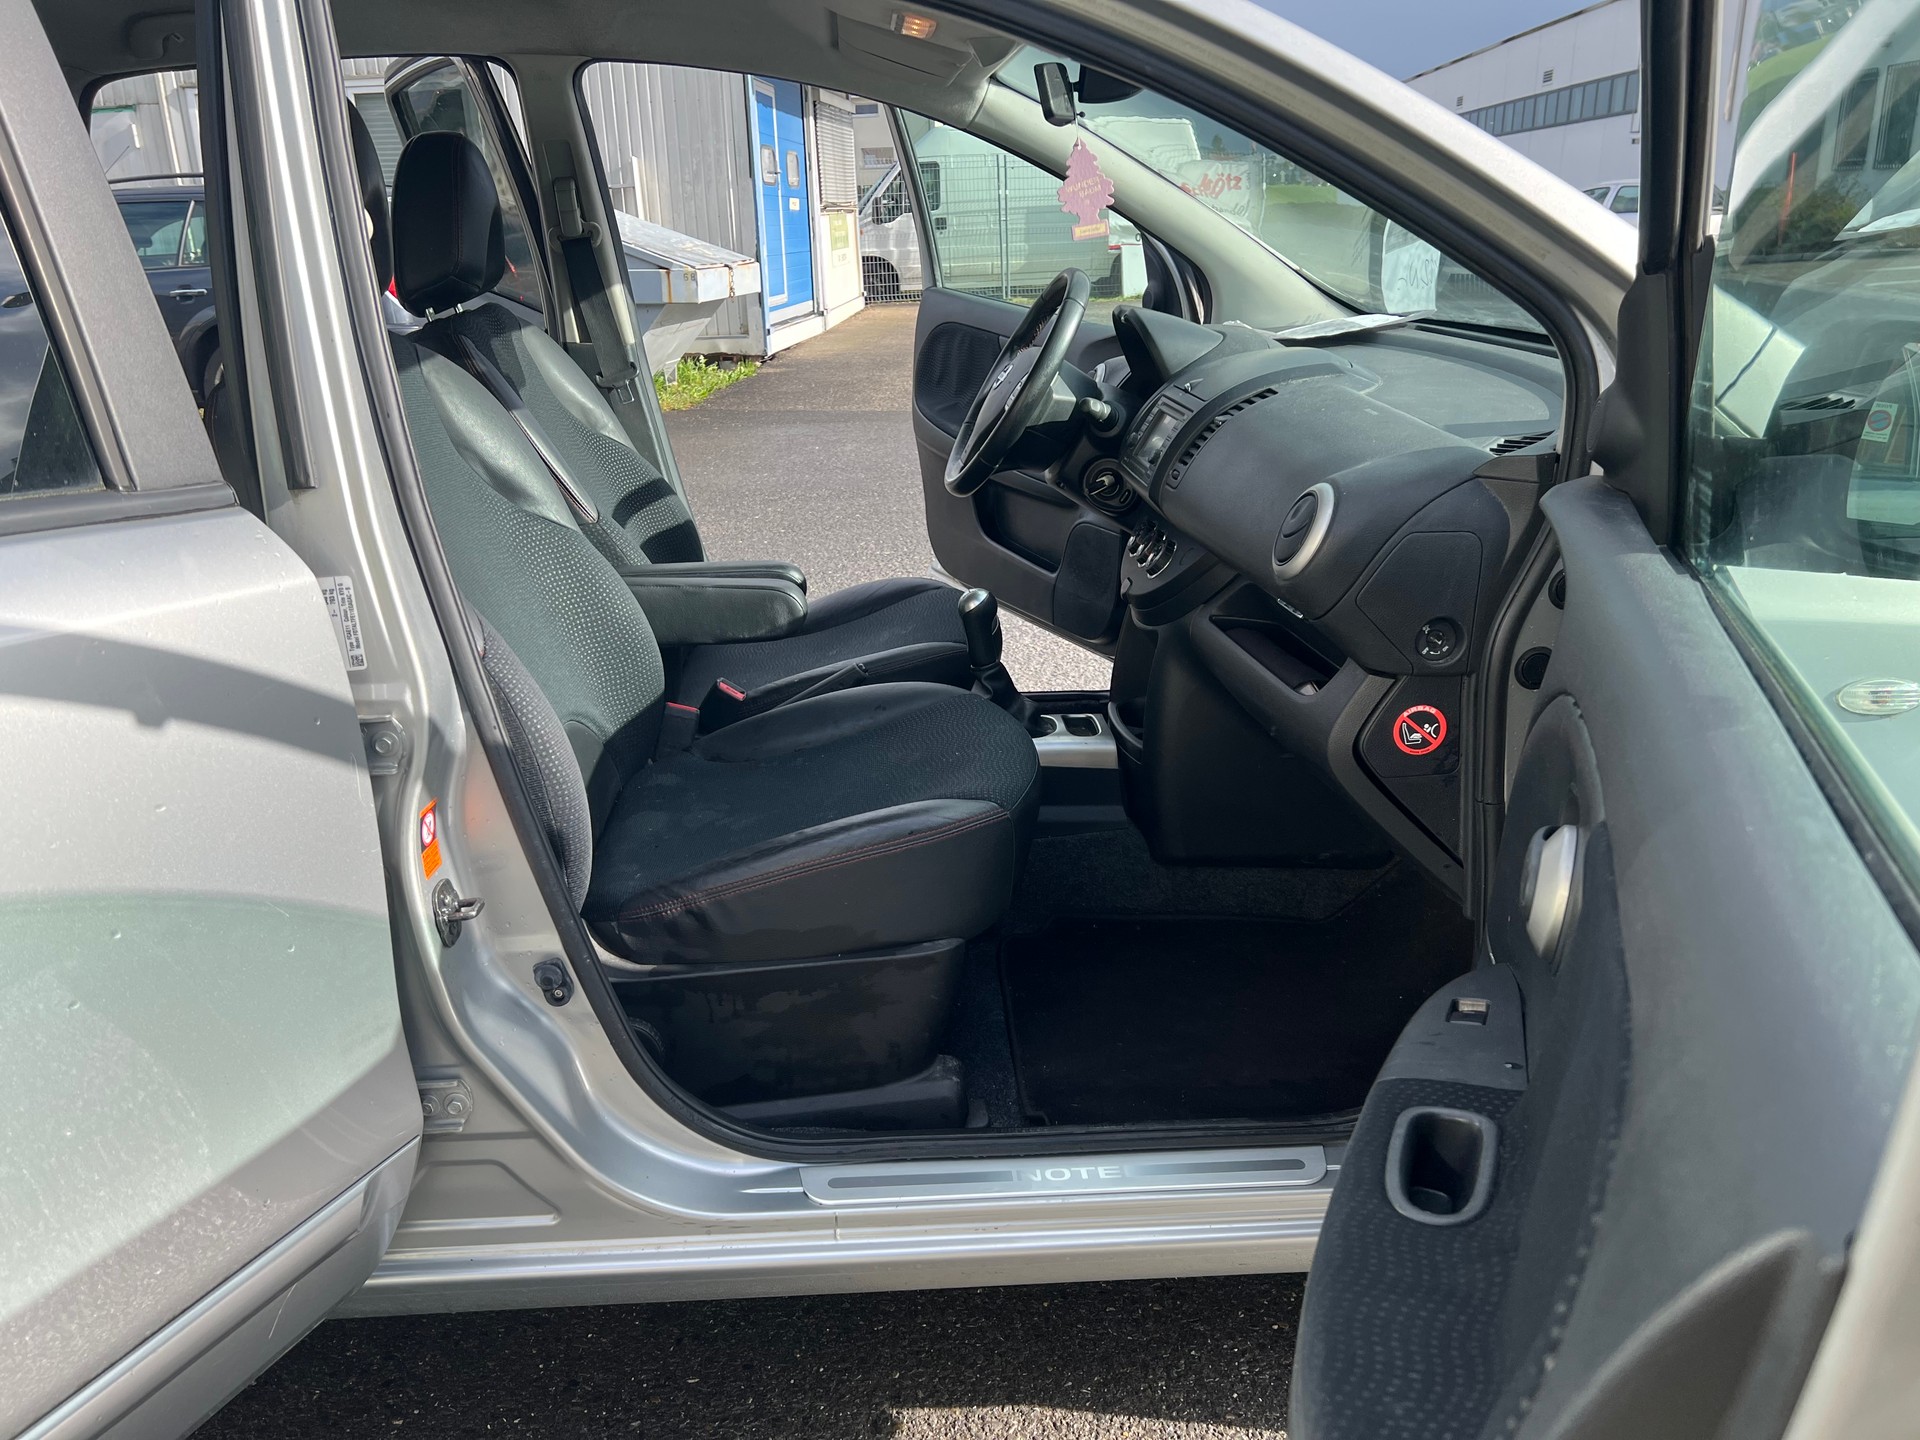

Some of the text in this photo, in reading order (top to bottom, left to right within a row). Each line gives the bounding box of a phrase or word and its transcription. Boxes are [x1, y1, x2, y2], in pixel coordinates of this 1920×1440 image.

[1066, 177, 1100, 193] WUNDER
[1079, 185, 1102, 198] BAUM
[1403, 704, 1437, 718] AIRBAG
[1017, 1165, 1122, 1182] NOTE
